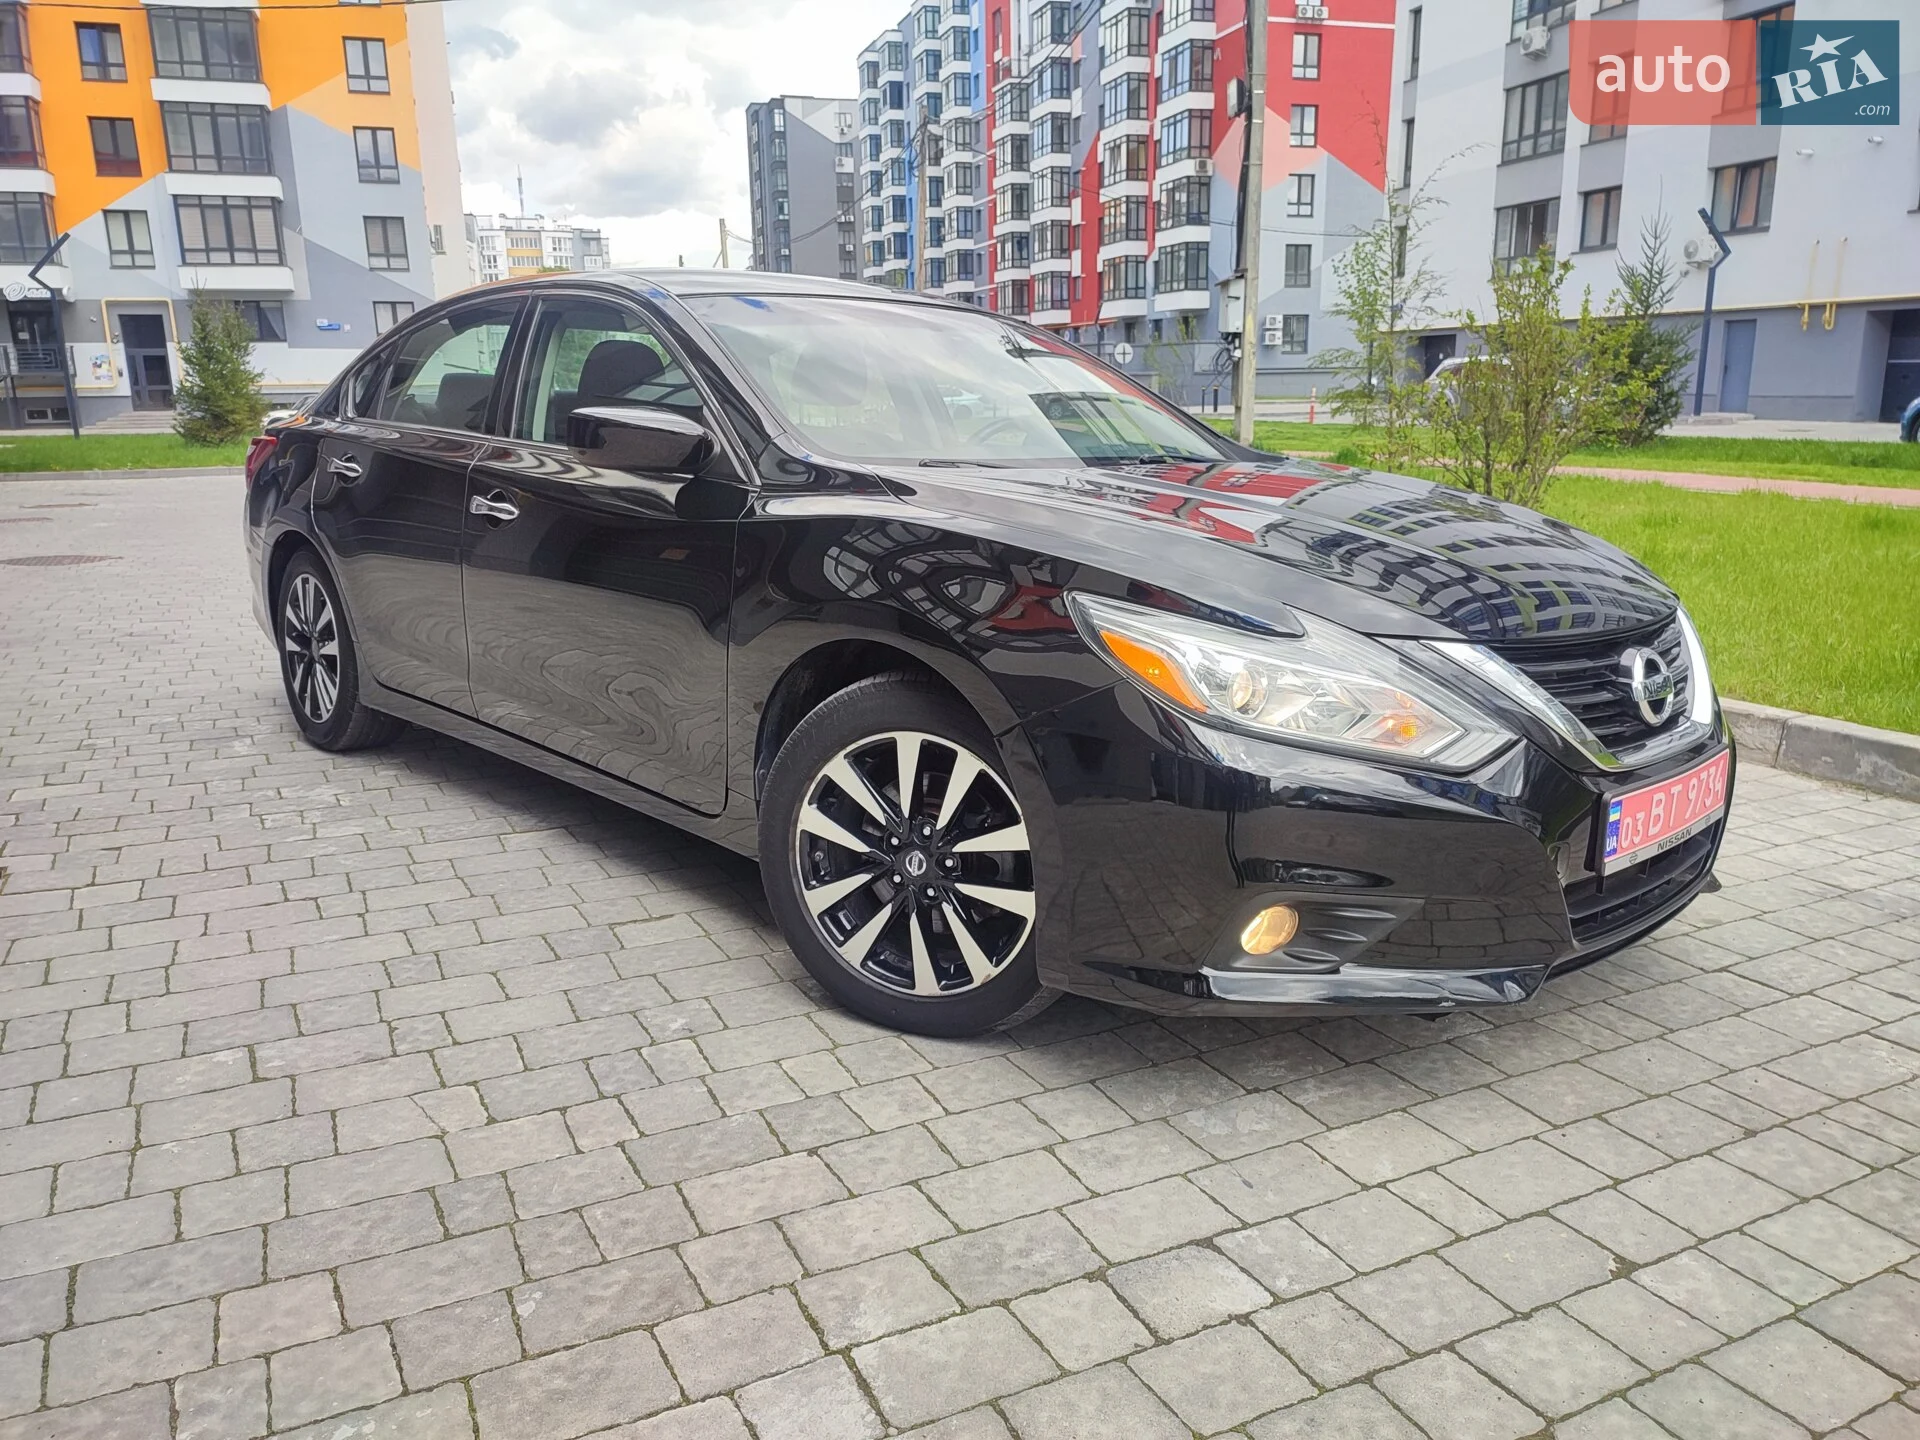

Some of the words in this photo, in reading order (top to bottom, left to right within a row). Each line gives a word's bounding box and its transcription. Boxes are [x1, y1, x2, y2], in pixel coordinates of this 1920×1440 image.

[1621, 811, 1646, 849] 03
[1648, 784, 1683, 837] BT
[1684, 759, 1724, 820] 9734
[1606, 835, 1617, 851] UA
[1656, 828, 1692, 853] NISSAN
